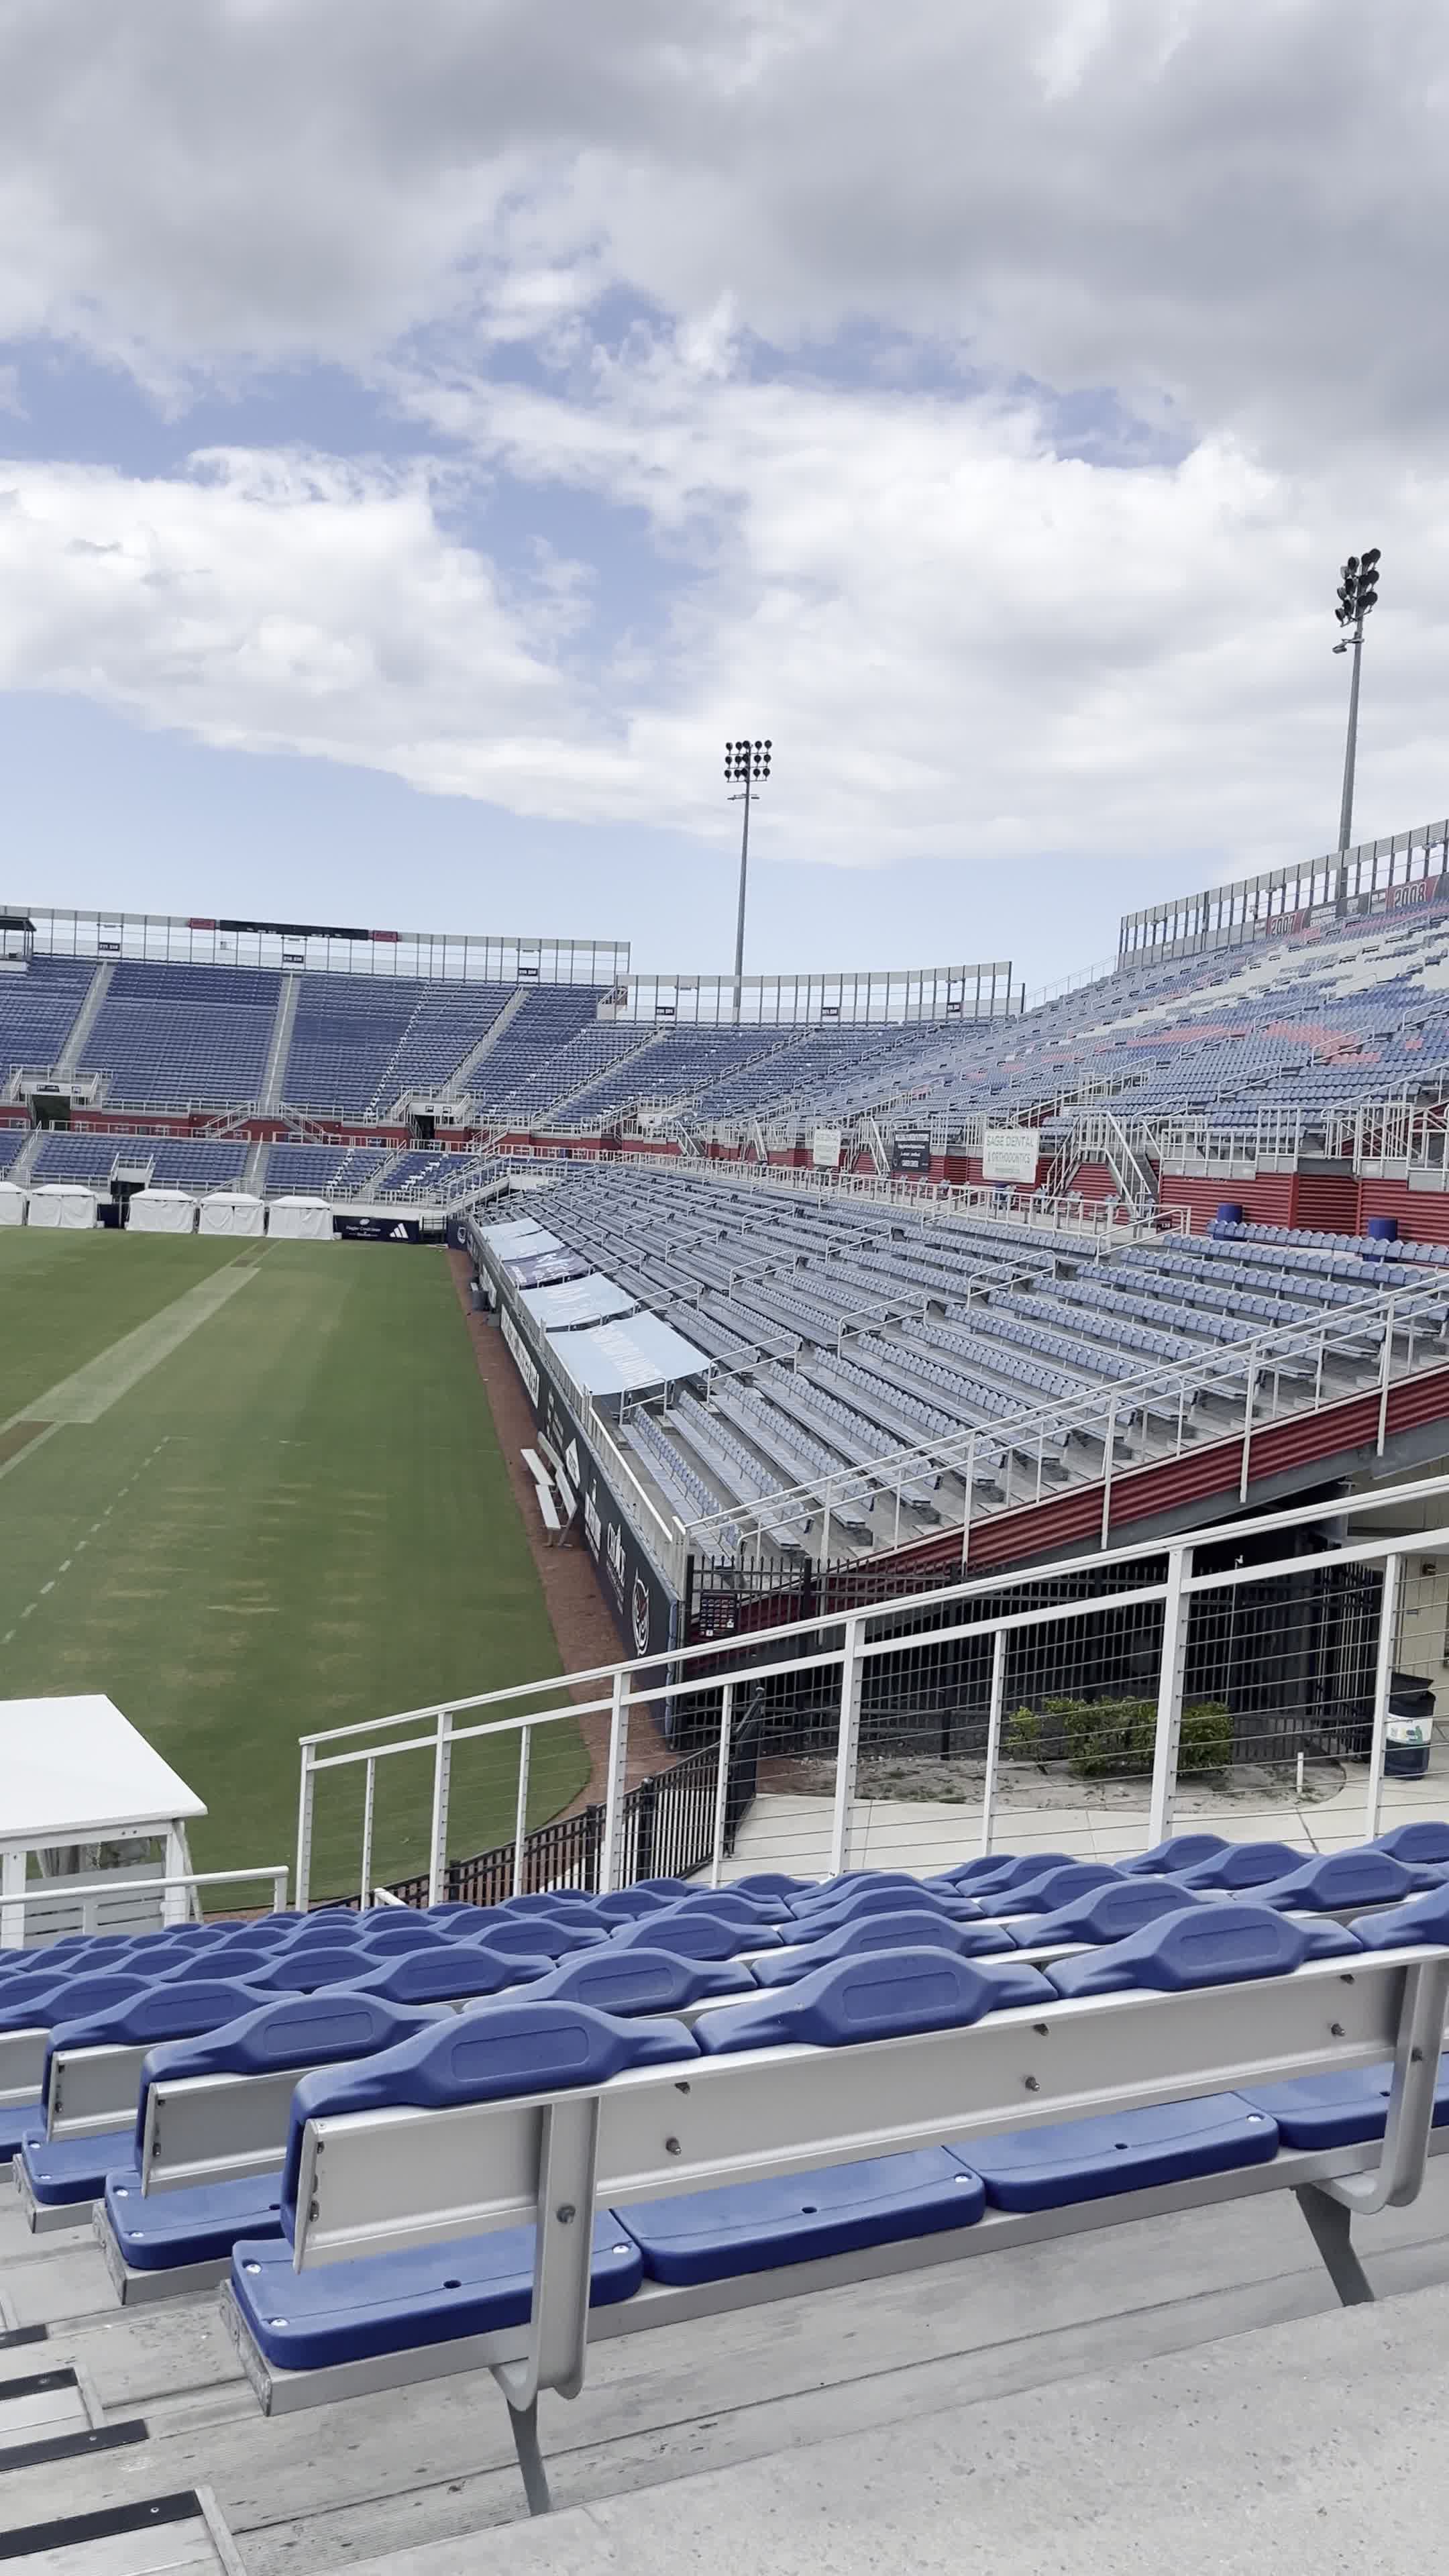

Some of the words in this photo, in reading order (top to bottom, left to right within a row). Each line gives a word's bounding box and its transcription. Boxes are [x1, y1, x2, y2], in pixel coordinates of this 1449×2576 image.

[1394, 882, 1426, 908] 2008
[1271, 913, 1297, 934] 2007
[987, 1135, 1004, 1146] SAGE
[1006, 1136, 1034, 1147] DENTAL
